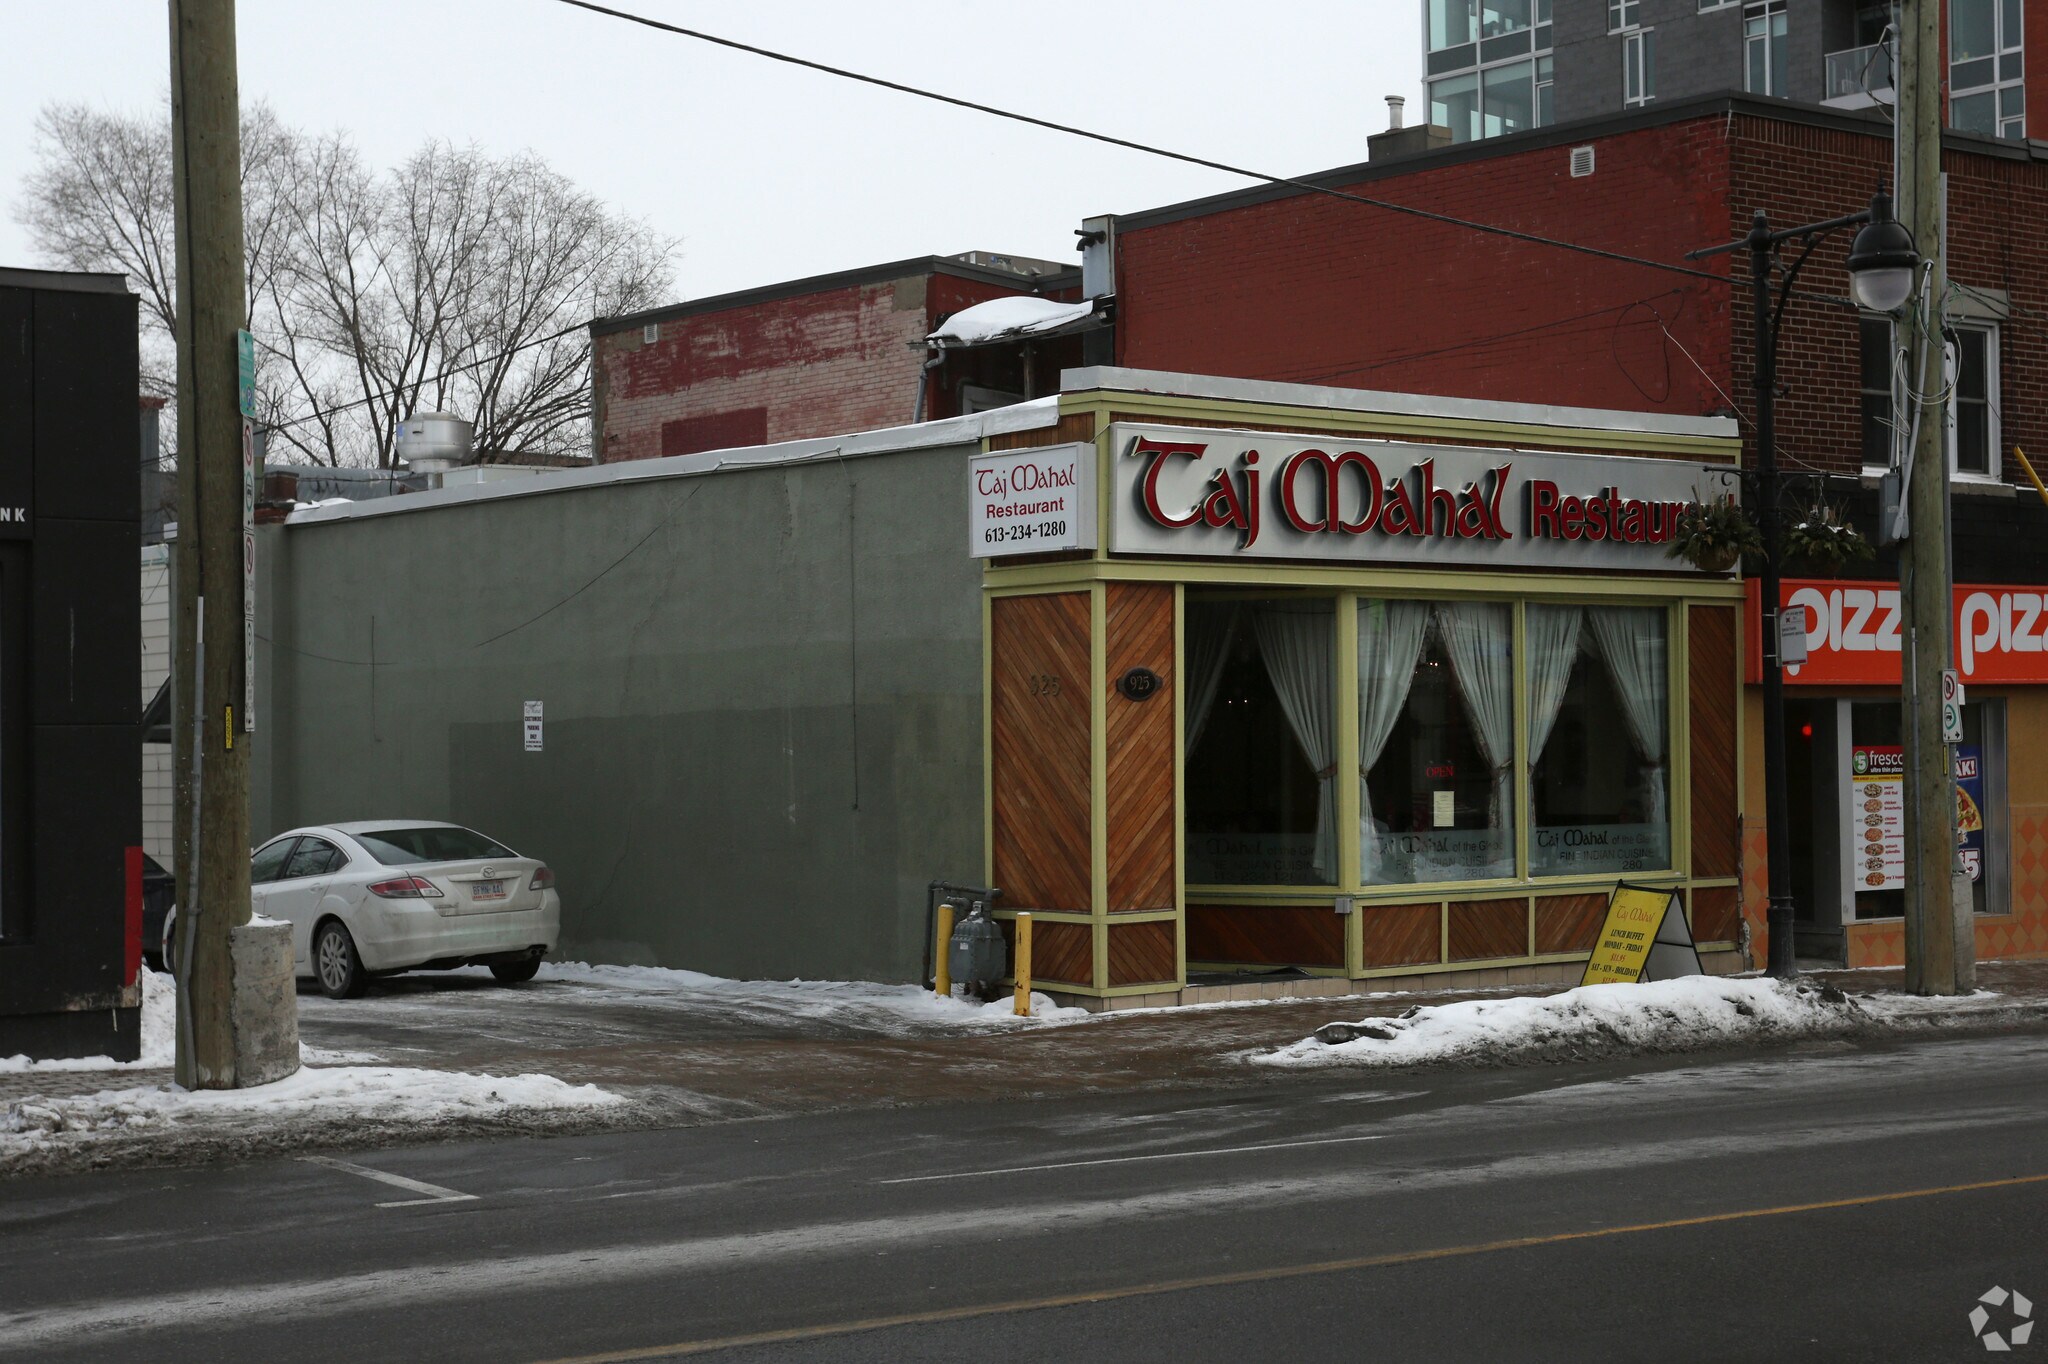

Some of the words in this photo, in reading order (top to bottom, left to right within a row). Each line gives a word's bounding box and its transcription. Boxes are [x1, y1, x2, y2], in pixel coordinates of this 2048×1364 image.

[975, 469, 1007, 501] Taj
[1011, 463, 1076, 492] Mahal
[1130, 435, 1260, 550] Taj
[1280, 448, 1513, 540] Mahal
[1530, 479, 1735, 544] Restaur
[0, 507, 26, 522] NK
[986, 497, 1065, 519] Restaurant
[985, 520, 1066, 543] 613-234-1280
[1030, 674, 1061, 696] 925
[1129, 674, 1150, 691] 925
[1426, 766, 1455, 778] OPEN
[1956, 759, 1977, 777] AK!
[1536, 830, 1559, 848] Taj
[1563, 829, 1609, 847] Mahal
[1462, 854, 1489, 867] CUISIN
[1559, 850, 1582, 861] FINE
[1583, 849, 1616, 861] INDIAN
[1616, 848, 1655, 859] CUISINE
[1273, 860, 1314, 871] CUISIN
[1611, 929, 1627, 938] LUNCH
[1626, 930, 1645, 941] BUFFET
[1603, 940, 1623, 949] MONDAY
[1625, 943, 1643, 953] FRIDAY
[1591, 963, 1600, 971] SAT
[1602, 964, 1612, 973] SUN
